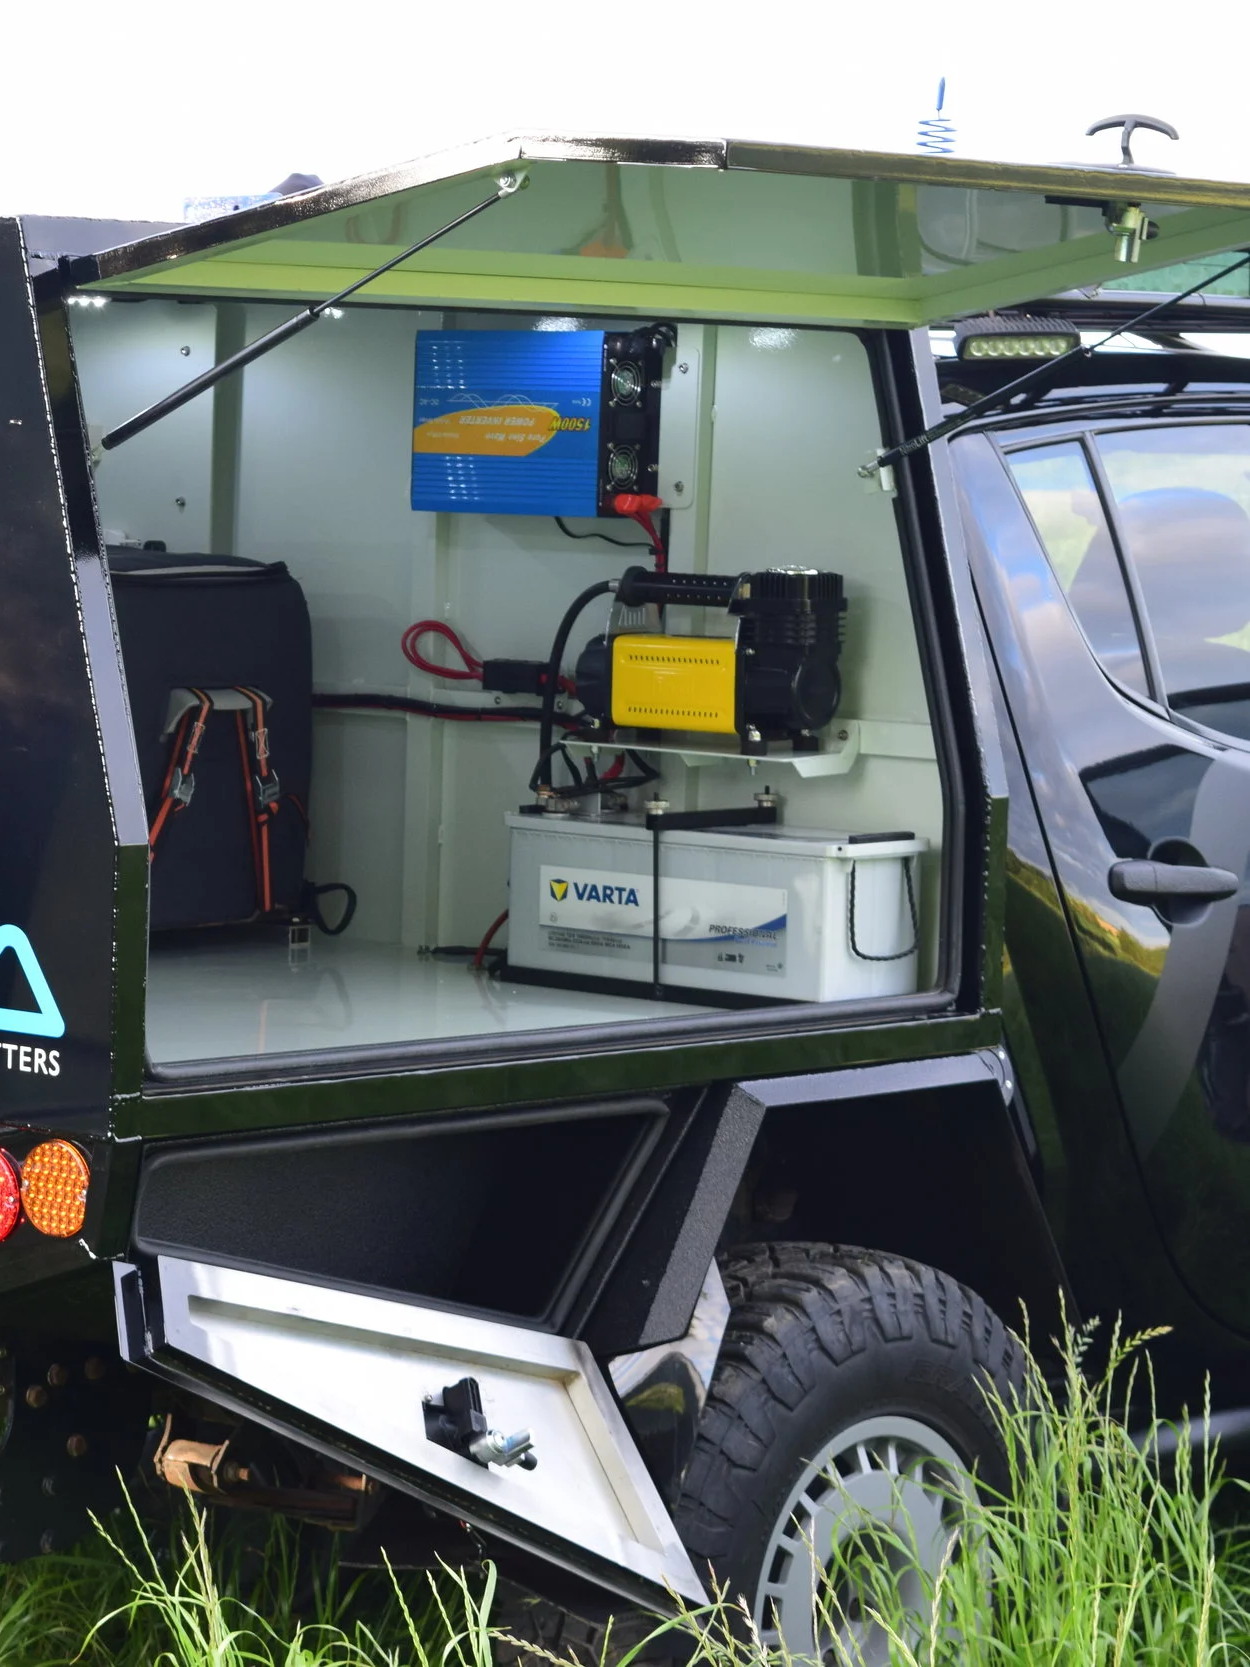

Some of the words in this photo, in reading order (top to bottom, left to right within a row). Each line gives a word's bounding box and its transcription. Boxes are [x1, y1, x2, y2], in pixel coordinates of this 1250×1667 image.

[459, 415, 502, 425] INVERTER
[504, 416, 535, 427] POWER
[548, 416, 591, 432] 1500W
[573, 882, 639, 907] VARTA
